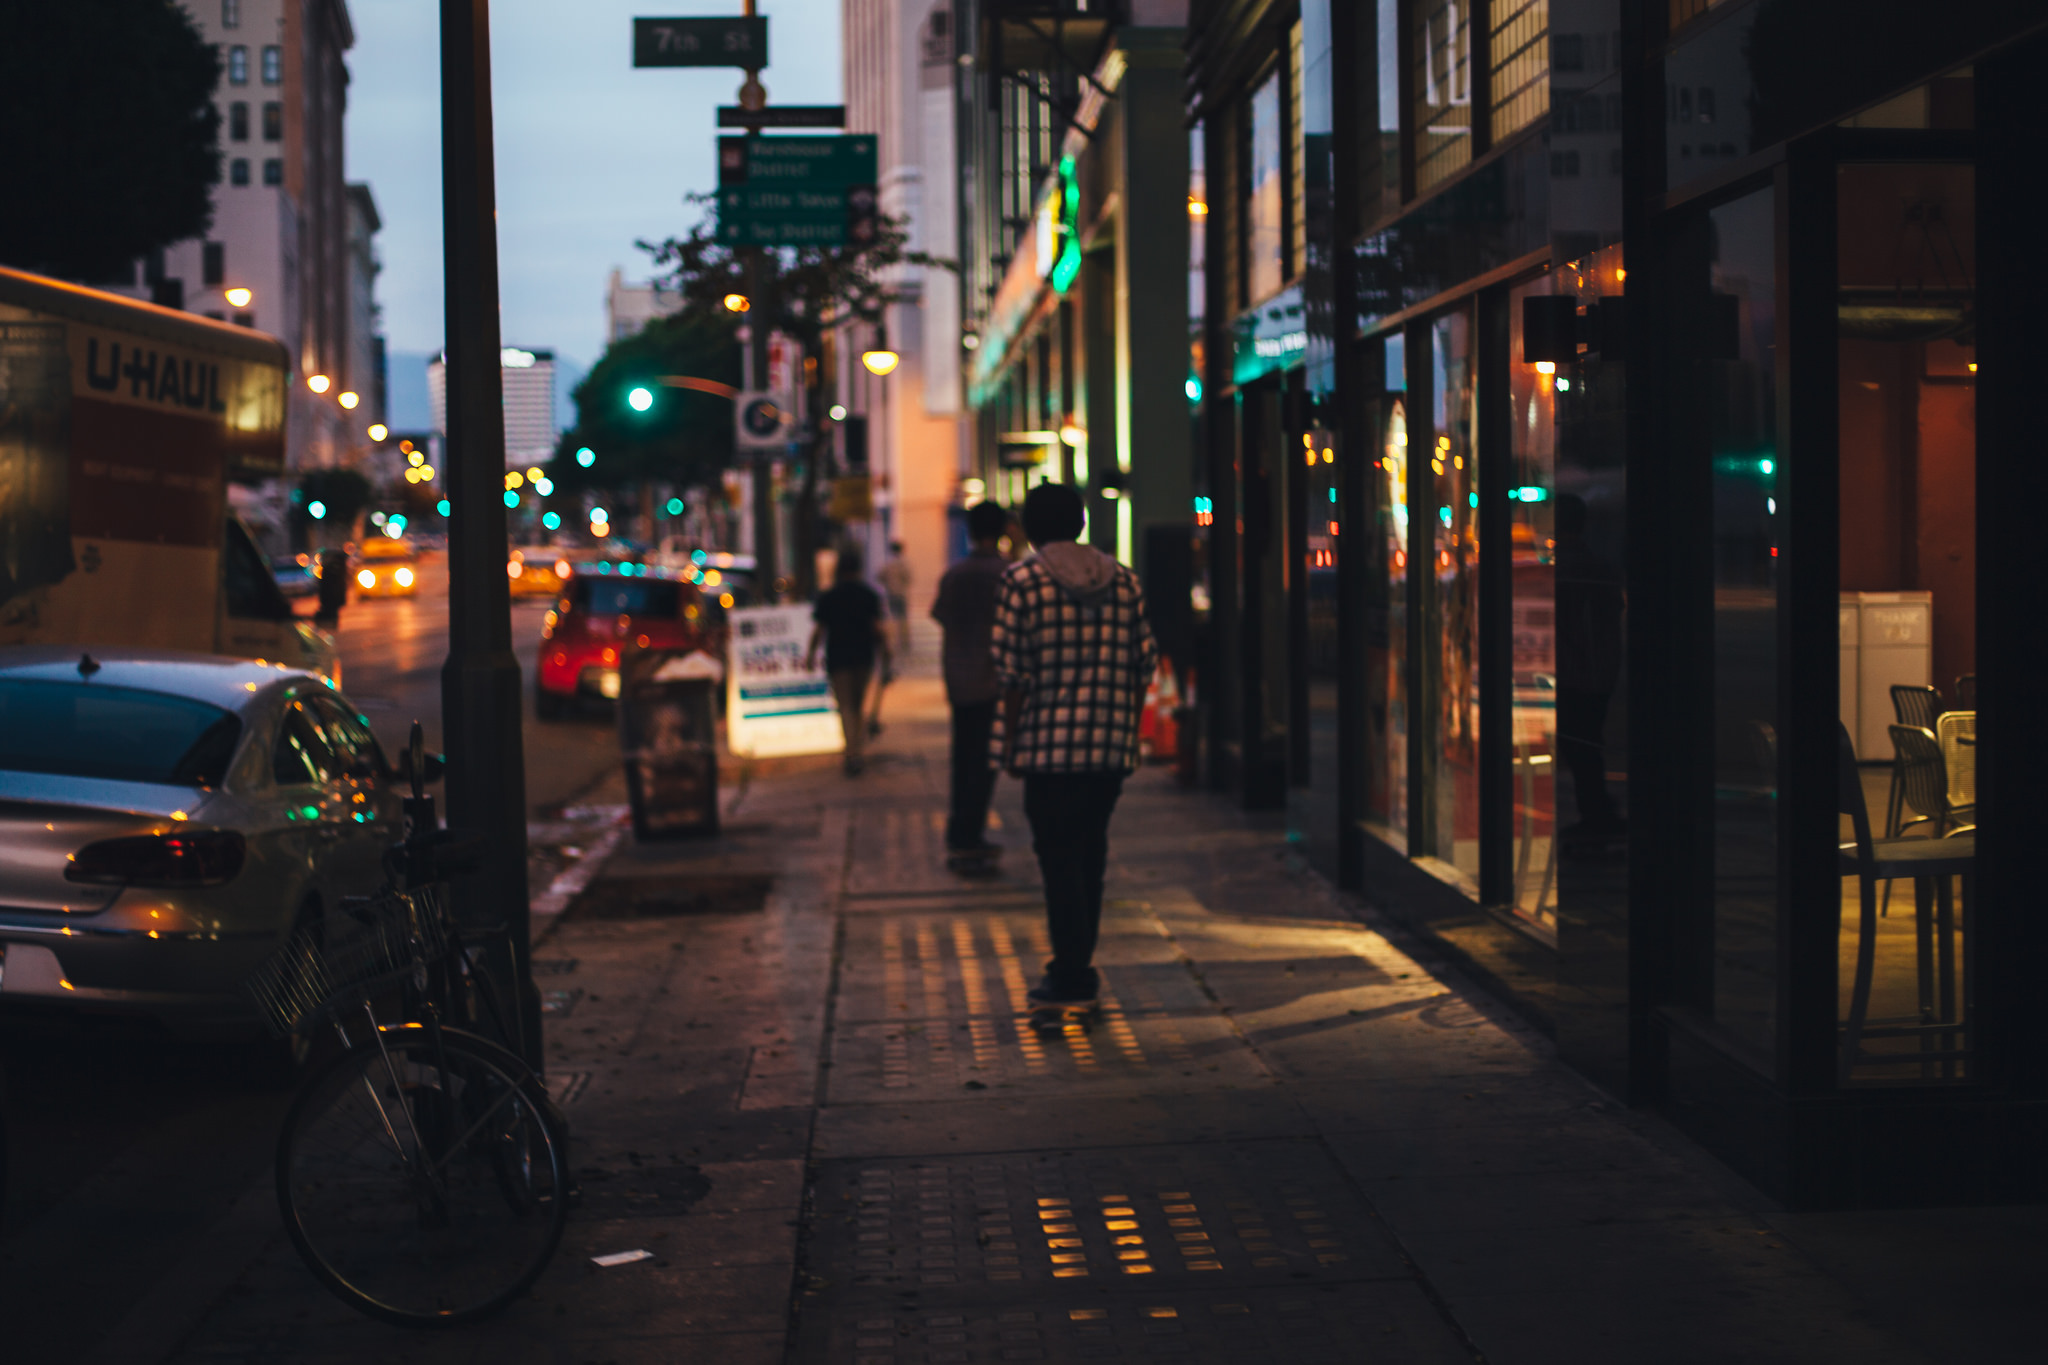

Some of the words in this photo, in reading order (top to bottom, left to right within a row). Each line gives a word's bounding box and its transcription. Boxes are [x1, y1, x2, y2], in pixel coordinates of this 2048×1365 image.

[653, 27, 700, 52] 7th
[723, 31, 753, 53] St
[88, 338, 226, 412] U-HAUL
